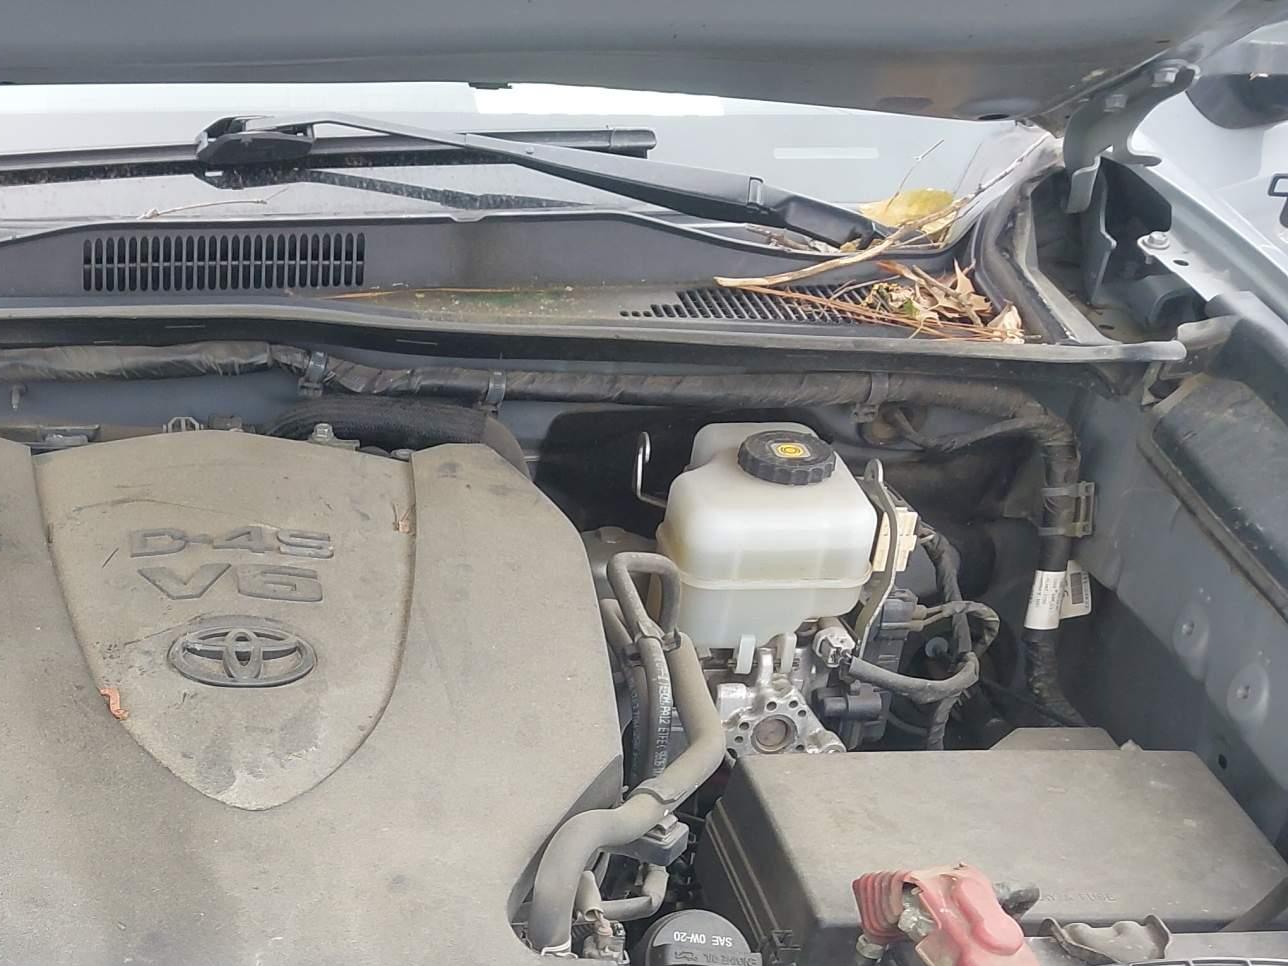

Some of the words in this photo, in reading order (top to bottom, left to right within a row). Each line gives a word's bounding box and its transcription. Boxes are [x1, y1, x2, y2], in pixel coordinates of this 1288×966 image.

[130, 524, 335, 559] D-4S
[137, 562, 323, 603] V6
[673, 931, 706, 944] 0W-20
[711, 936, 733, 947] SAE
